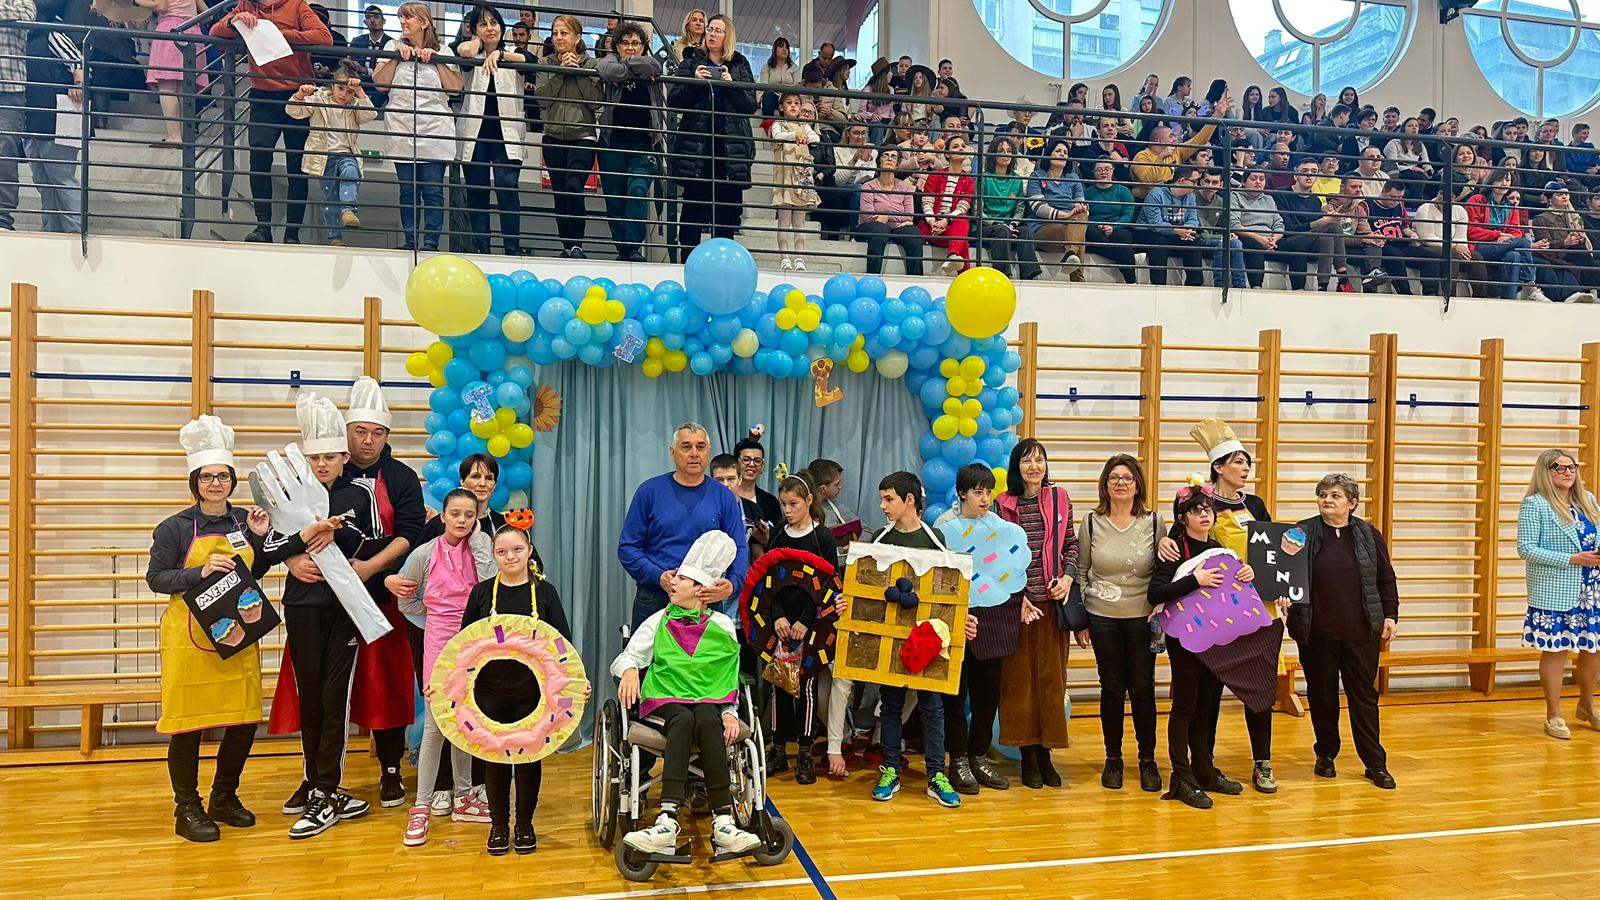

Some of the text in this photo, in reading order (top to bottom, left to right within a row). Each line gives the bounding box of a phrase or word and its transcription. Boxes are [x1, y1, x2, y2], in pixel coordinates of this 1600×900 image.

[463, 383, 495, 422] T
[810, 357, 844, 408] L
[1250, 531, 1304, 601] MENU
[197, 571, 240, 608] MENU
